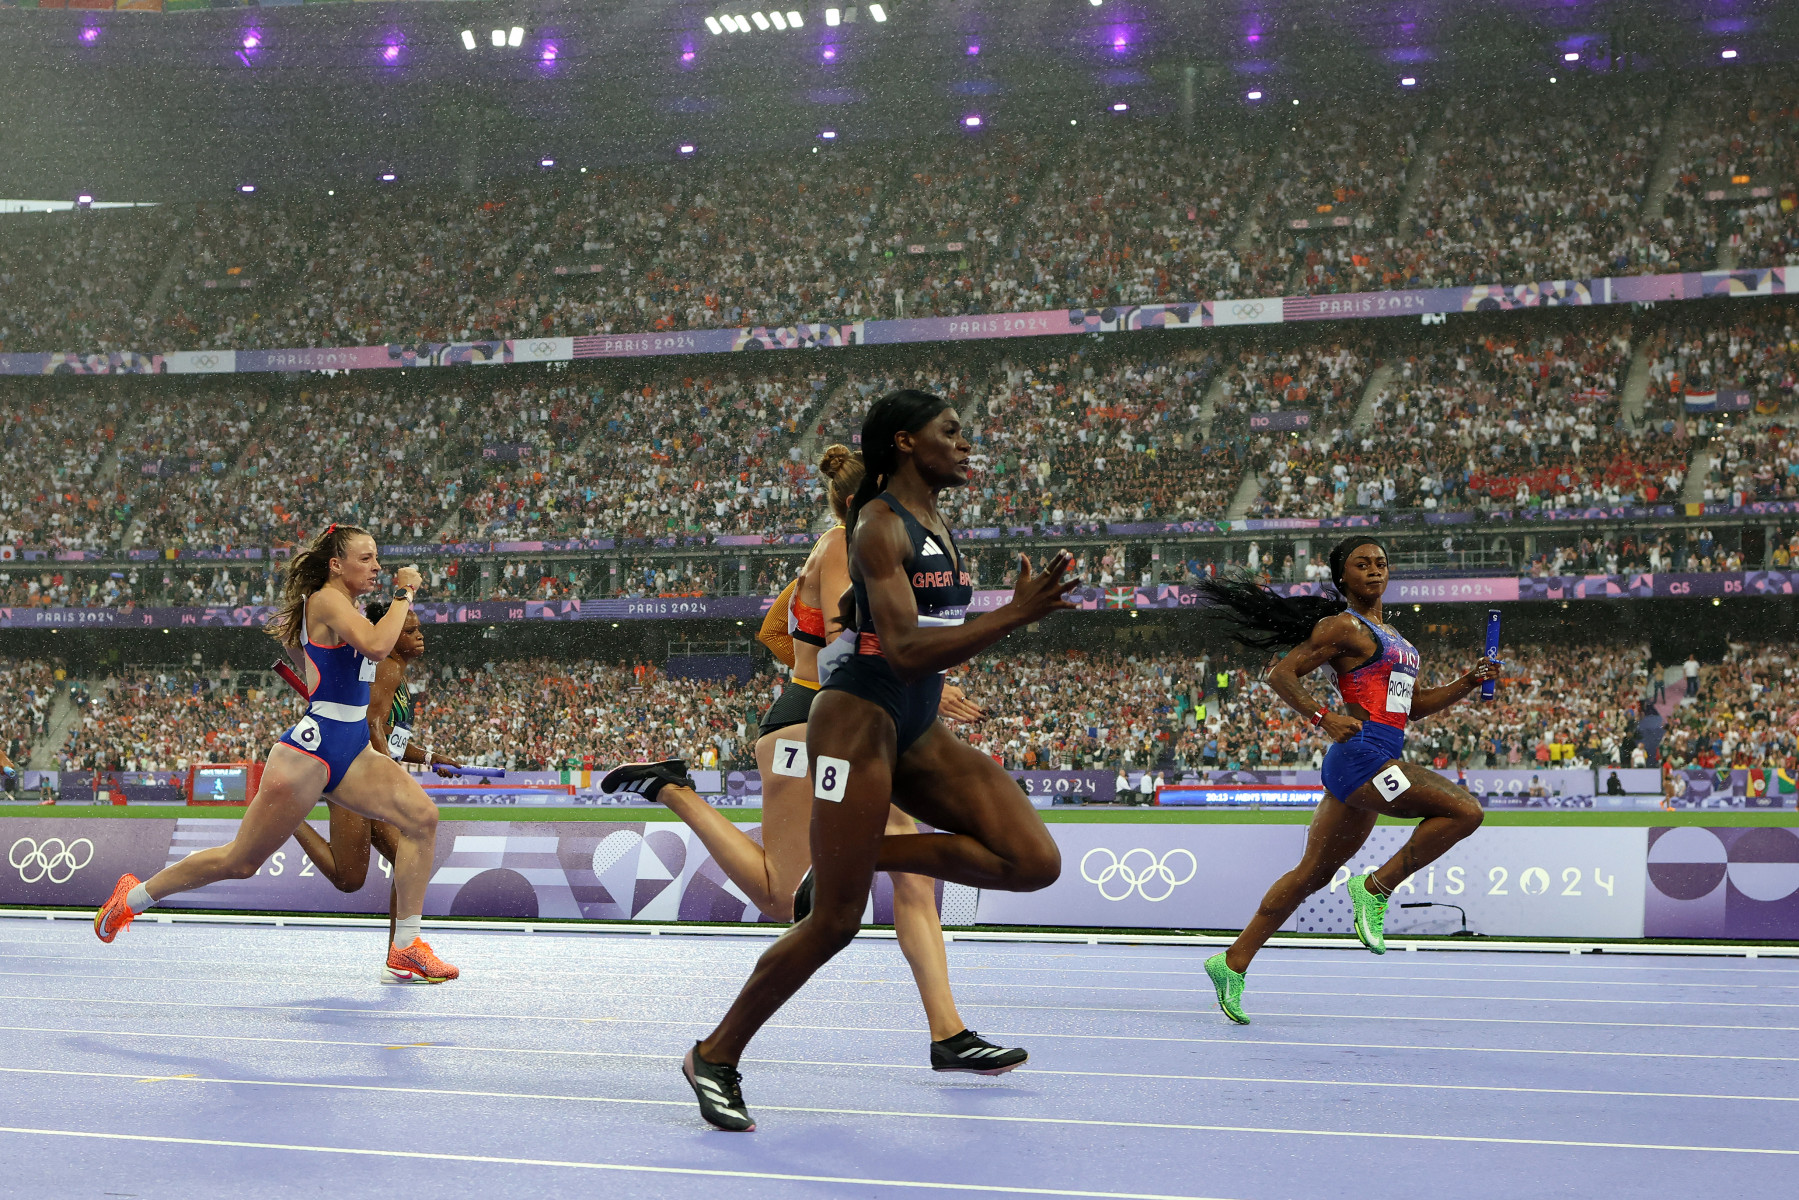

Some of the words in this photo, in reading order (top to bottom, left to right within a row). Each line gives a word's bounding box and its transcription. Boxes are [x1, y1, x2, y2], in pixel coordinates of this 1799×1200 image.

[1319, 299, 1371, 313] PARIS
[1378, 295, 1424, 310] 2024
[950, 320, 997, 333] PARIS
[1004, 318, 1047, 331] 2024
[605, 339, 648, 351] PARIS
[654, 336, 695, 350] 2024
[913, 570, 954, 588] GREAT
[1724, 580, 1742, 592] D5
[1400, 585, 1445, 596] PARIS
[1451, 584, 1492, 595] 2024
[468, 609, 481, 619] H3
[509, 608, 524, 619] H2
[628, 603, 666, 613] PARIS
[671, 603, 706, 613] 2024
[36, 612, 74, 623] PARIS
[78, 612, 113, 623] 2024
[182, 614, 196, 624] H4
[301, 726, 315, 742] 6
[784, 746, 799, 768] 7
[822, 766, 837, 791] 8
[1042, 778, 1096, 793] 2024
[1383, 774, 1399, 791] 5
[1206, 793, 1228, 802] 20:13
[1235, 793, 1260, 802] MEN'S
[1261, 793, 1288, 802] TRIPLE
[1289, 793, 1311, 802] JUMP
[1330, 865, 1466, 894] PRIS
[1488, 866, 1614, 897] 2024
